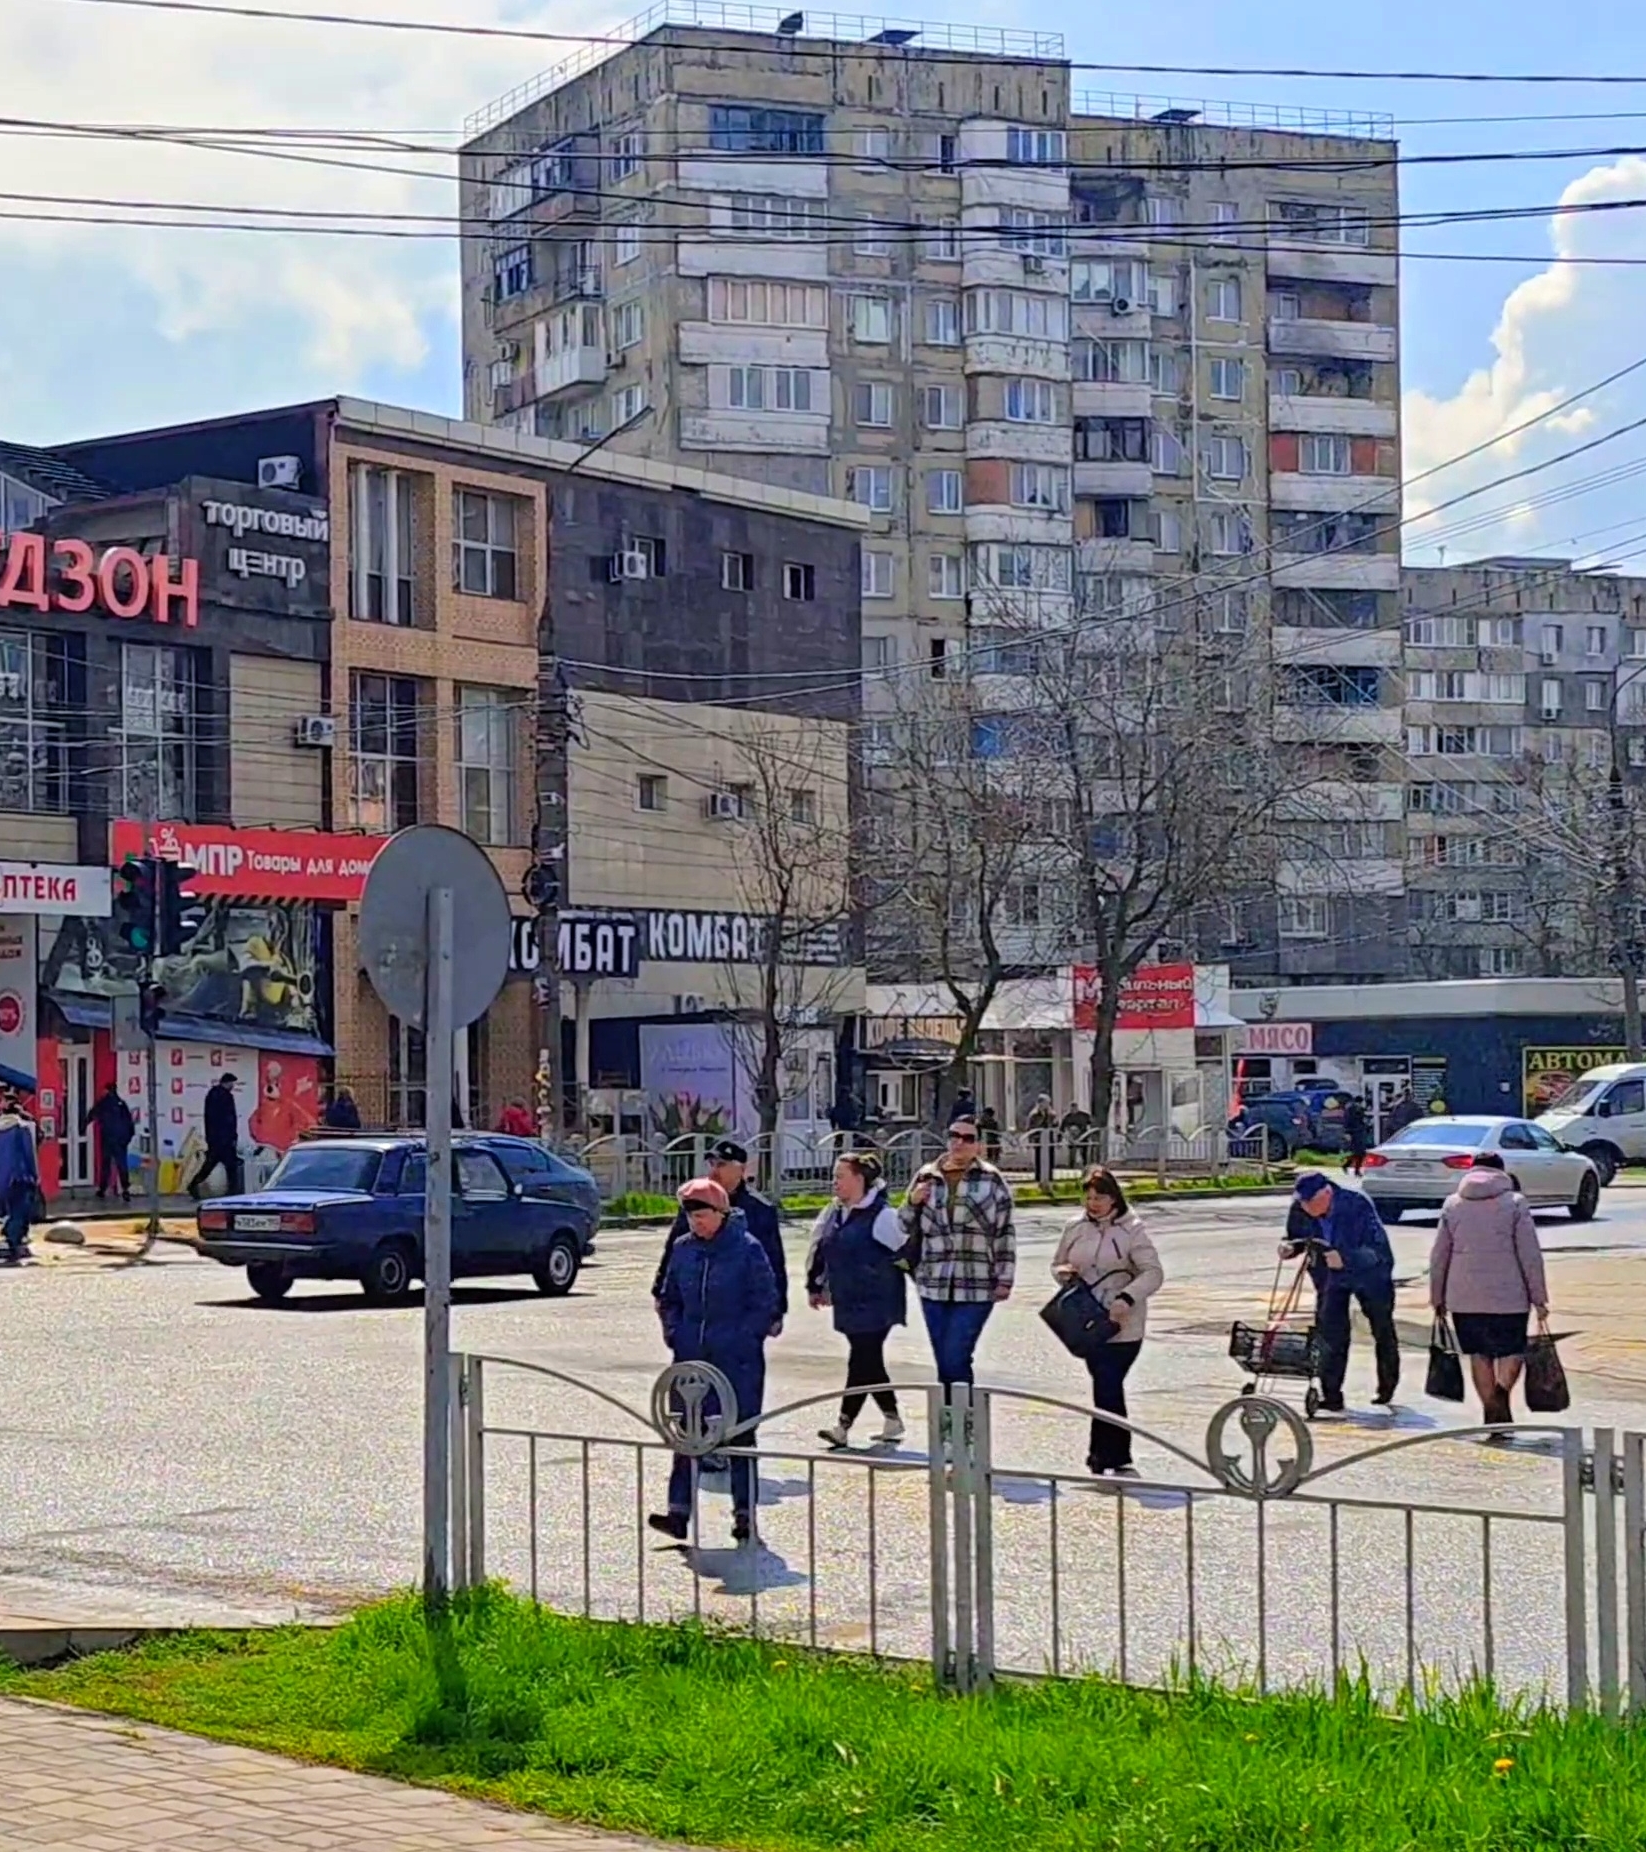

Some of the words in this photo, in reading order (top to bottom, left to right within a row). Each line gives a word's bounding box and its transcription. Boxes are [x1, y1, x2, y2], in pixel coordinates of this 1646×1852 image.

[184, 842, 243, 877] МПР
[246, 850, 302, 876] Товары
[305, 858, 334, 877] для
[649, 912, 764, 960] КОМБАТ
[1250, 1027, 1308, 1049] МЯСО
[1528, 1051, 1630, 1070] АВТОМА
